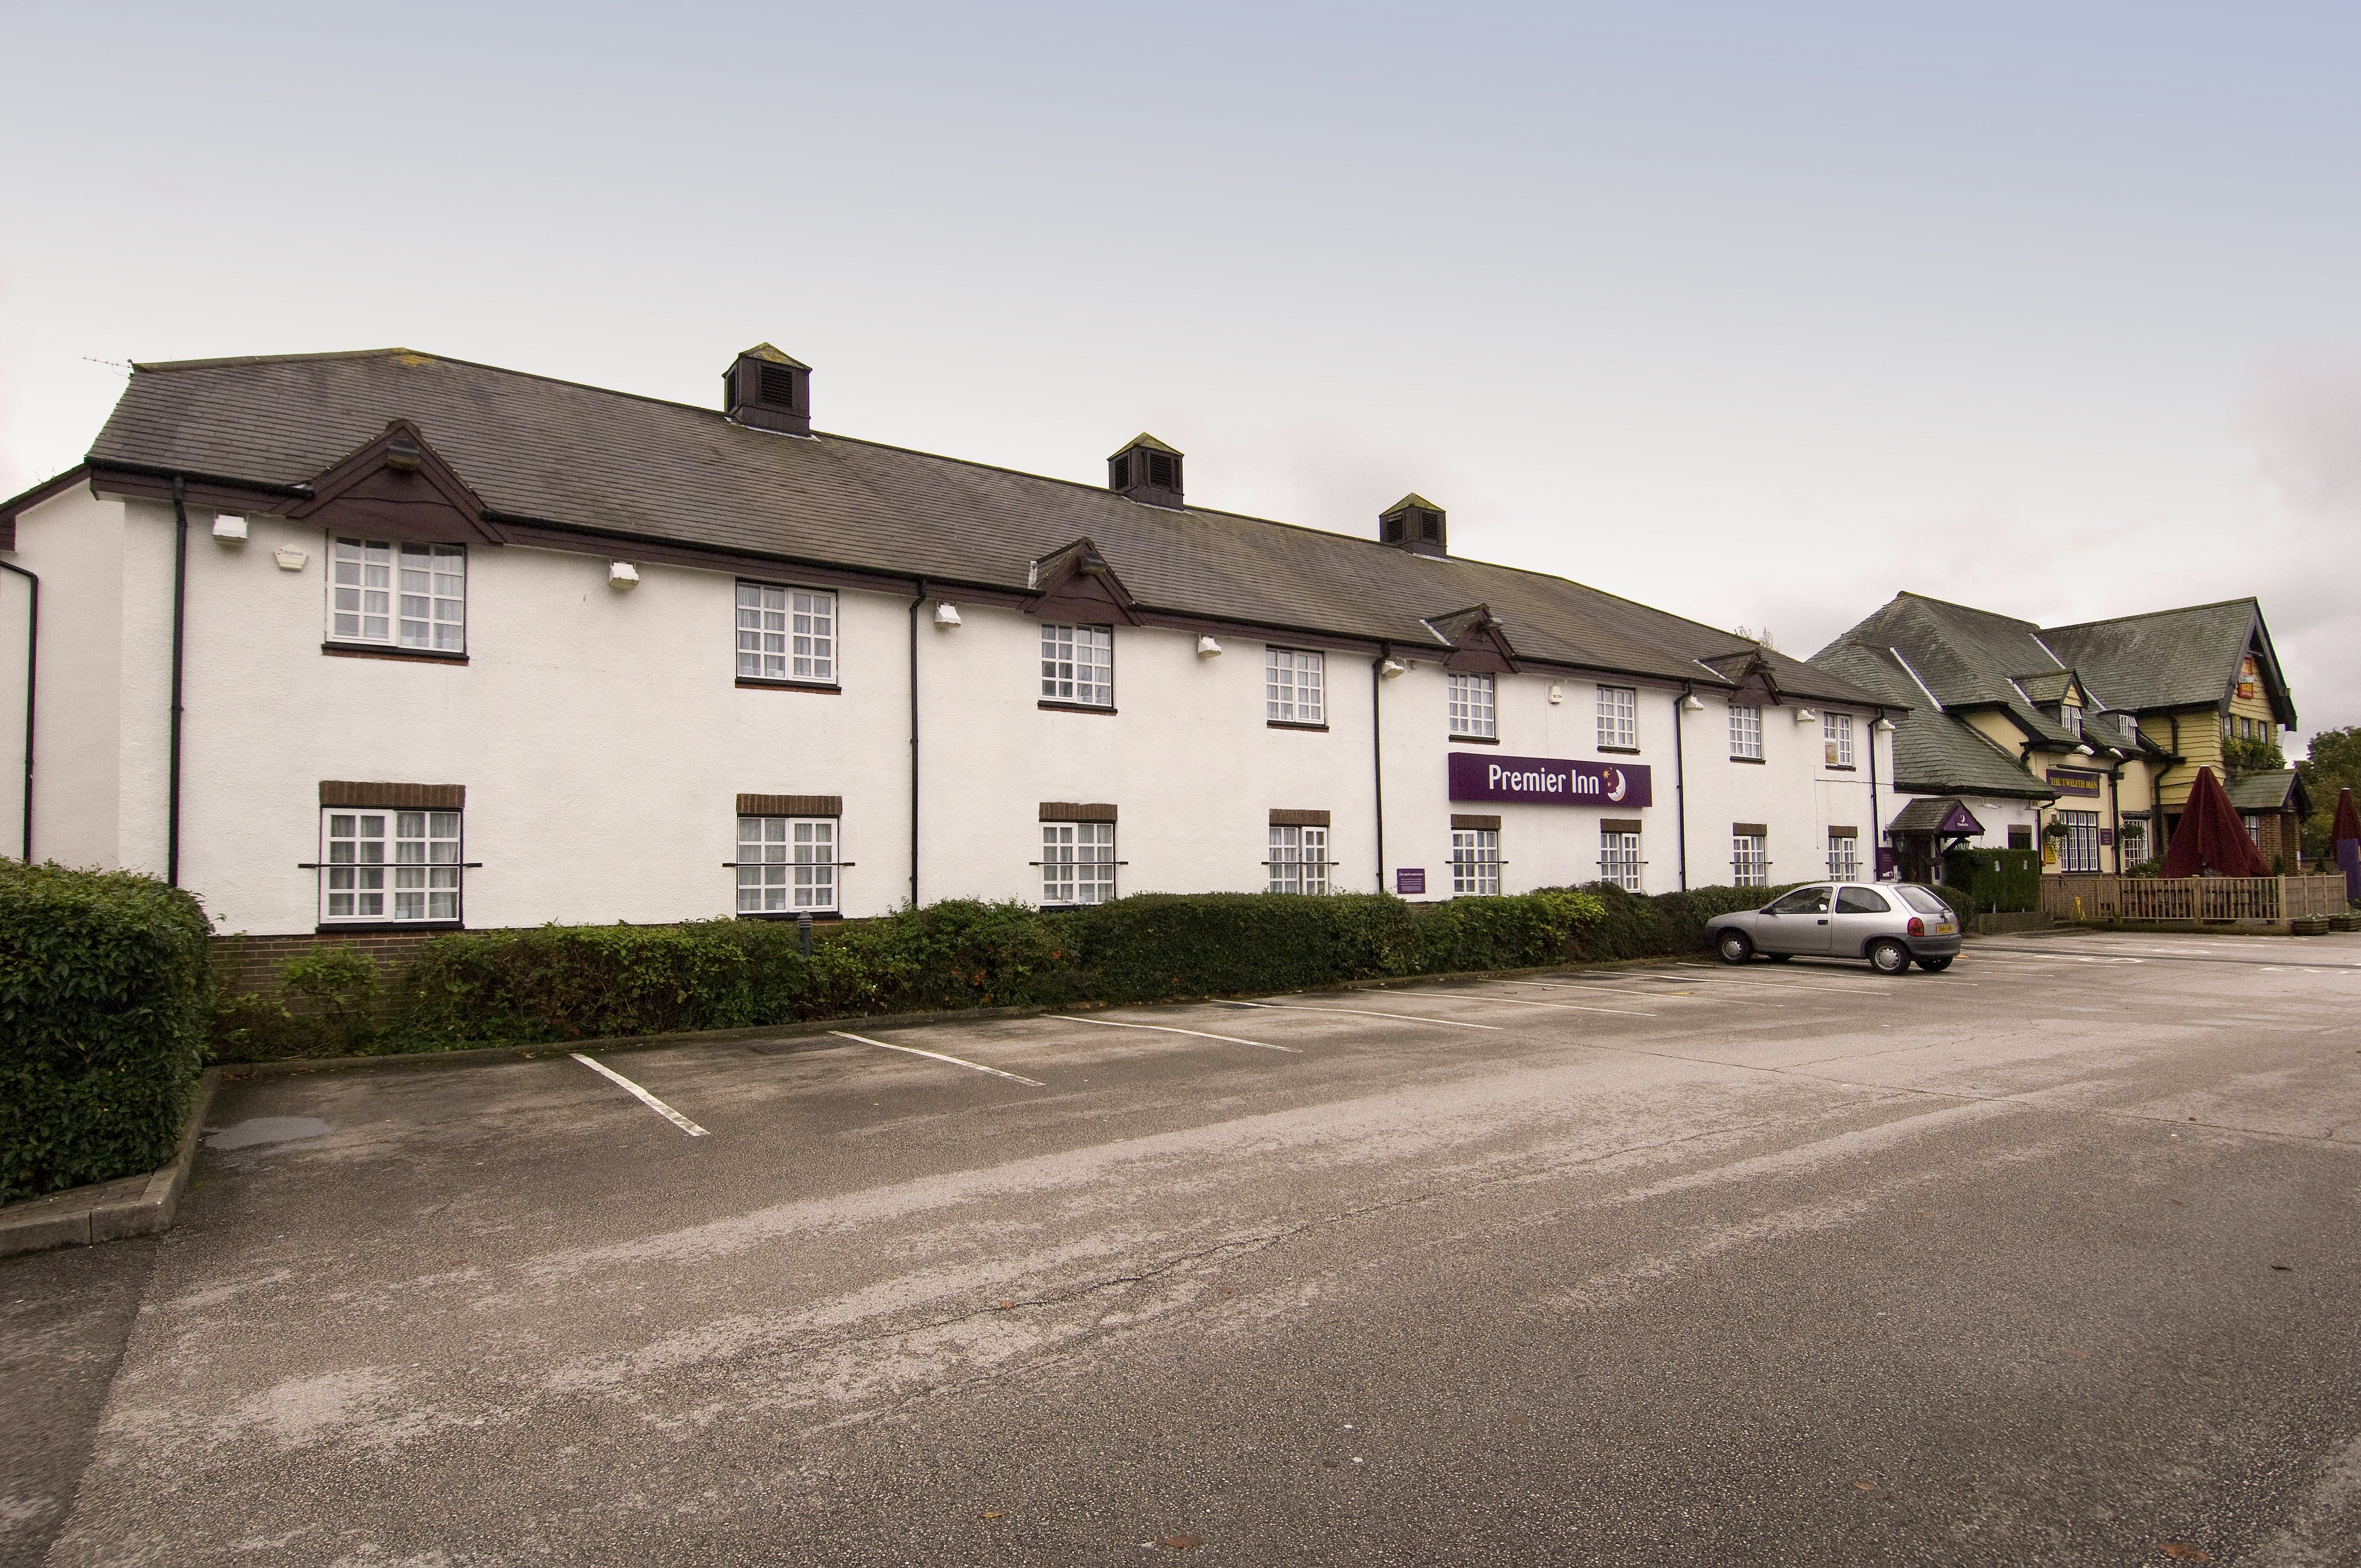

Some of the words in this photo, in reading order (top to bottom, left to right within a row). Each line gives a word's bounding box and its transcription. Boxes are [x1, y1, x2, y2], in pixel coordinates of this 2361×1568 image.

[1489, 764, 1566, 793] Premier
[1572, 769, 1599, 794] Inn
[2050, 777, 2061, 786] THE
